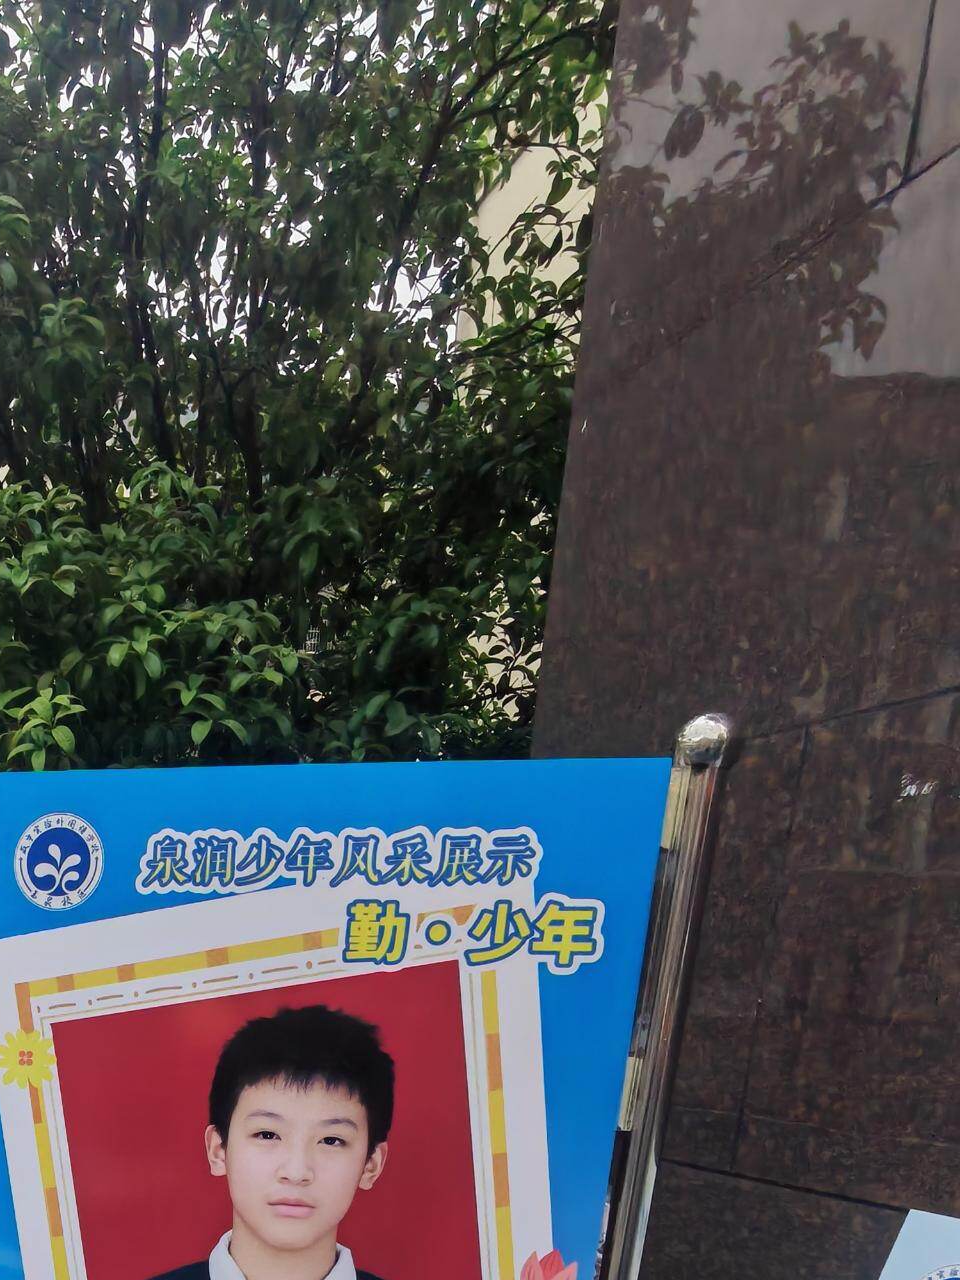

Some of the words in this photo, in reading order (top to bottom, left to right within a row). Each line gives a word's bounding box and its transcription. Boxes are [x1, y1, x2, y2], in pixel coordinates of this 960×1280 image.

[142, 833, 539, 889] 泉润少年风采展示
